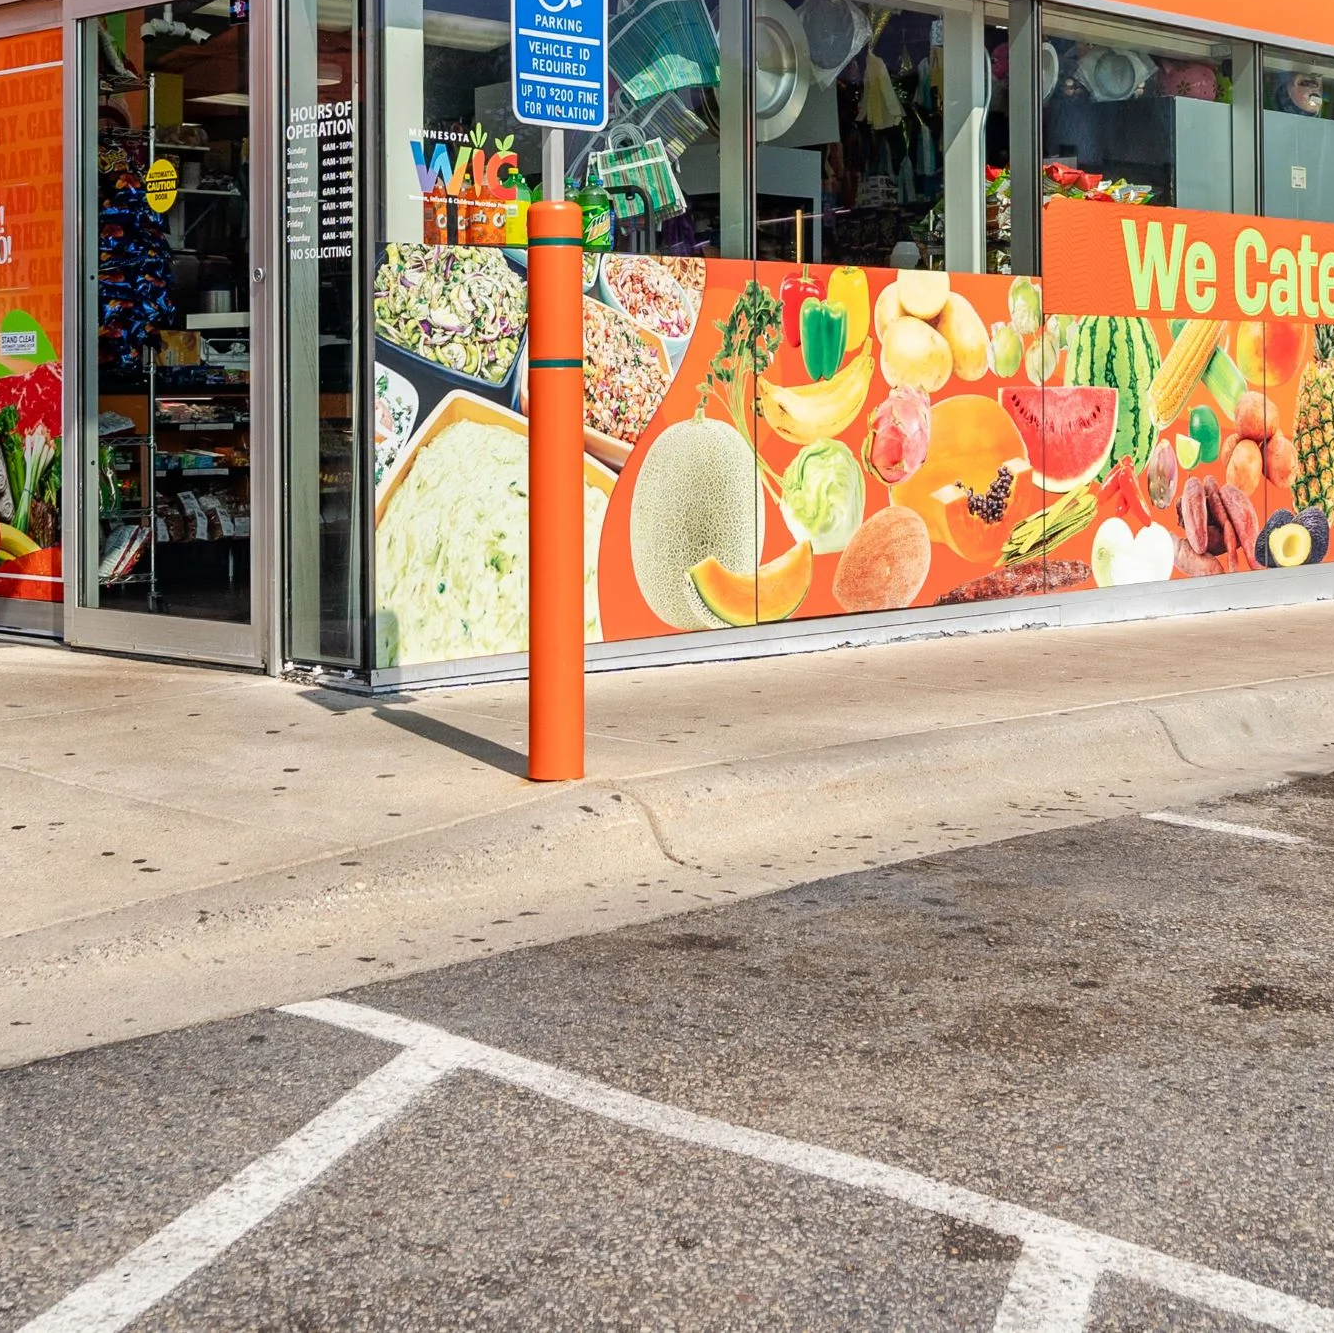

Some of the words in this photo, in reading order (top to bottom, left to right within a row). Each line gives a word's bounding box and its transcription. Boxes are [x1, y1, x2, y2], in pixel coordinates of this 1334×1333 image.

[534, 14, 583, 33] PARKING
[528, 40, 573, 59] VEHICLE
[579, 46, 590, 61] ID
[532, 57, 586, 77] REQUIRED
[521, 84, 533, 97] UP
[535, 85, 546, 99] TO
[549, 87, 574, 102] $200
[578, 90, 598, 105] FINE
[290, 103, 333, 124] HOURS
[335, 101, 352, 117] OF
[524, 101, 541, 115] FOR
[545, 103, 596, 121] VIOLATION
[286, 118, 355, 140] OPERATION
[408, 128, 470, 143] MINNESOTA
[149, 170, 175, 179] AUTOMATIC
[410, 139, 518, 201] WIC
[147, 180, 176, 192] CAUTION
[290, 248, 304, 260] NO
[305, 245, 352, 260] SOLICITING
[1120, 218, 1217, 313] We
[1, 336, 18, 344] STAND
[19, 335, 35, 343] CLEAR
